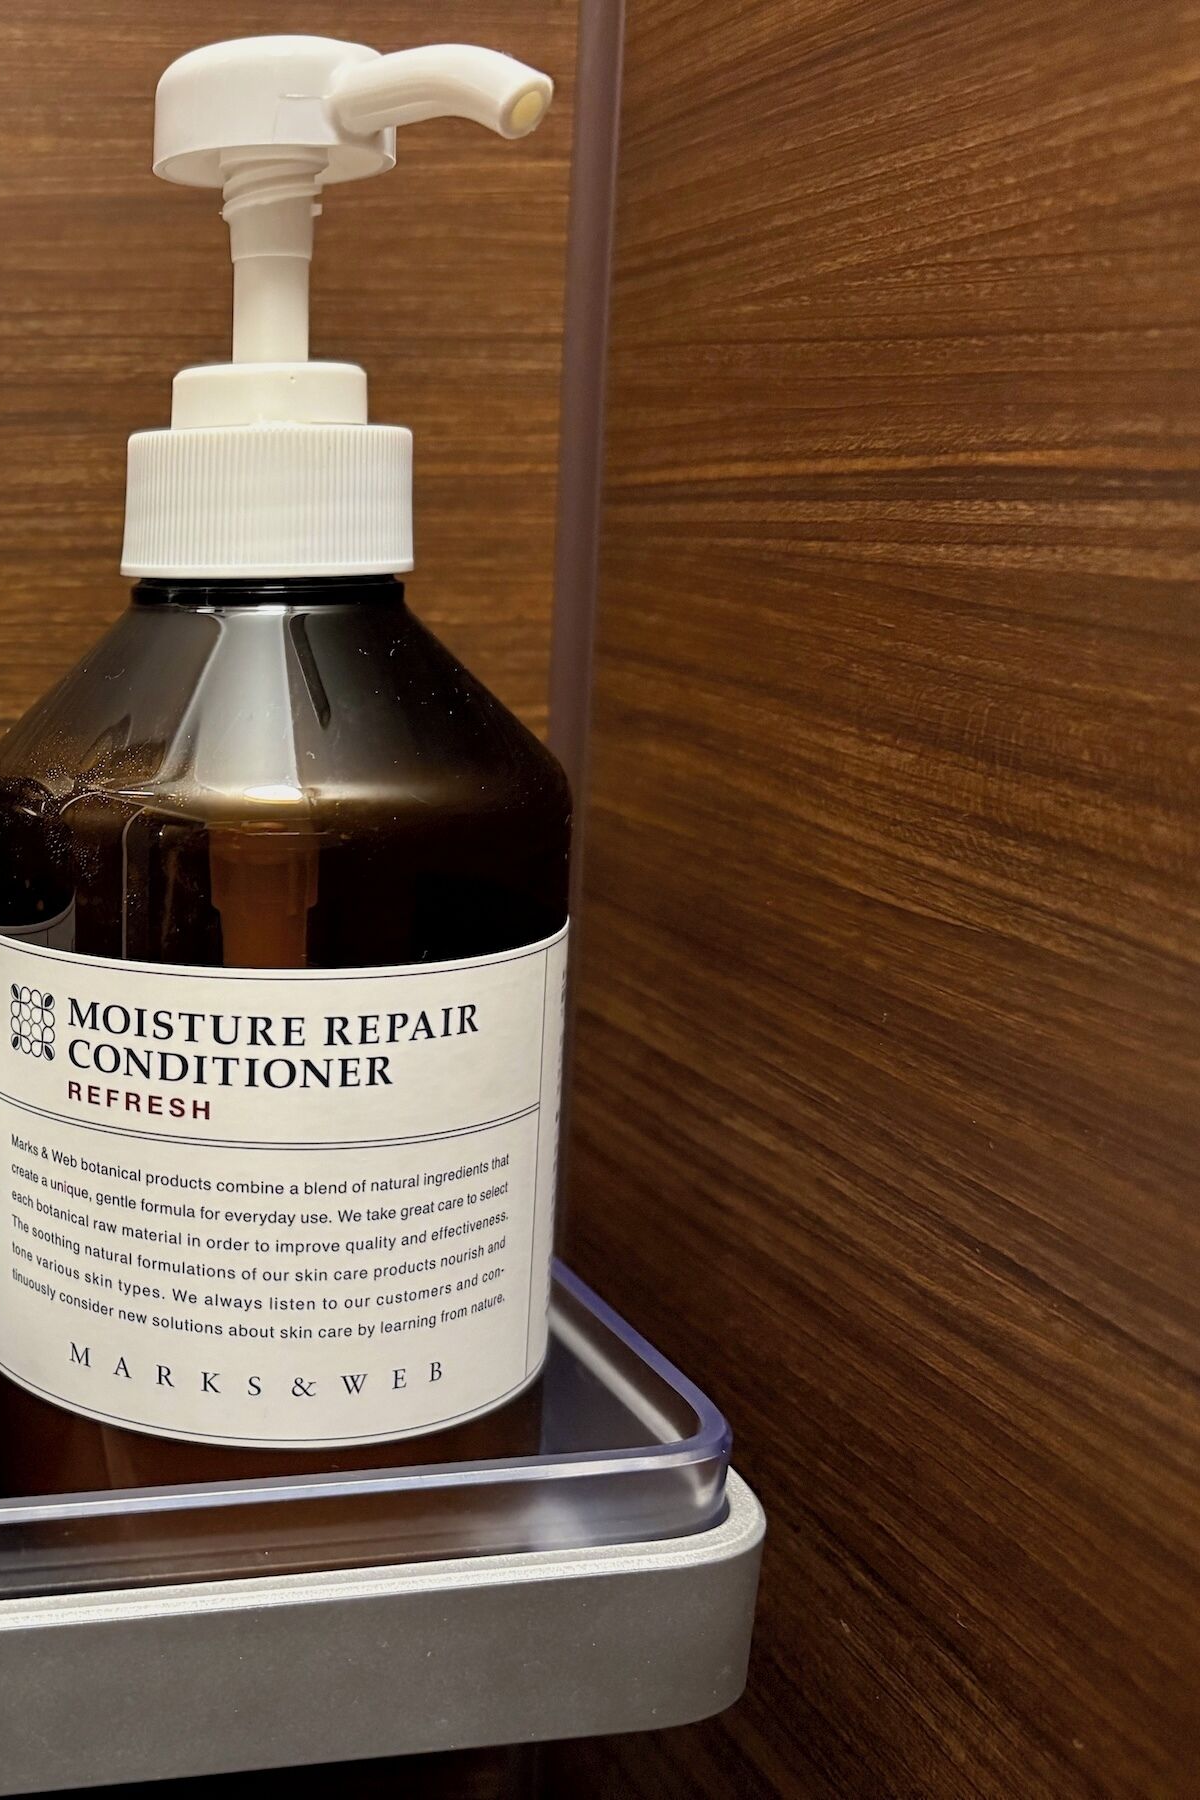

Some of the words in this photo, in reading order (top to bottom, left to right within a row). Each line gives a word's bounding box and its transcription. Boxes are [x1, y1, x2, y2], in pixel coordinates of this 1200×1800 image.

[67, 997, 306, 1046] MOISTURE
[323, 1004, 478, 1046] REPAIR
[68, 1039, 393, 1089] CONDITIONER
[68, 1080, 210, 1120] REFRESH
[11, 1133, 39, 1157] Marks
[41, 1146, 49, 1160] &
[51, 1149, 78, 1168] Web
[80, 1157, 141, 1182] botanical
[145, 1173, 212, 1191] products
[216, 1180, 285, 1195] combine
[289, 1184, 299, 1195] a
[304, 1180, 347, 1195] blend
[351, 1179, 367, 1193] of
[370, 1174, 420, 1192] natural
[423, 1162, 489, 1187] ingredients
[491, 1153, 509, 1170] that
[11, 1163, 39, 1184] create
[41, 1176, 48, 1187] a
[50, 1179, 92, 1203] unique,
[95, 1192, 137, 1210] gentle
[140, 1198, 196, 1219] formula
[200, 1206, 221, 1221] for
[224, 1210, 296, 1228] everyday
[300, 1213, 332, 1224] use.
[337, 1209, 363, 1223] We
[366, 1207, 397, 1221] take
[400, 1201, 435, 1221] great
[437, 1197, 464, 1212] care
[467, 1193, 477, 1205] to
[479, 1181, 508, 1202] select
[11, 1190, 34, 1209] each
[36, 1198, 89, 1227] botanical
[93, 1219, 117, 1234] raw
[122, 1226, 182, 1245] material
[187, 1233, 201, 1248] in
[206, 1237, 250, 1251] order
[254, 1239, 270, 1253] to
[275, 1239, 340, 1256] improve
[345, 1236, 397, 1255] quality
[401, 1230, 427, 1246] and
[431, 1211, 509, 1241] effectiveness.
[11, 1214, 29, 1234] The
[32, 1227, 80, 1255] soothing
[84, 1245, 132, 1266] natural
[137, 1254, 236, 1280] formulations
[241, 1267, 257, 1281] of
[262, 1271, 290, 1282] our
[295, 1268, 328, 1282] skin
[333, 1269, 368, 1281] care
[373, 1258, 436, 1281] products
[440, 1245, 485, 1268] nourish
[487, 1235, 506, 1254] and
[12, 1241, 33, 1262] tone
[36, 1255, 80, 1280] various
[84, 1272, 113, 1289] skin
[118, 1279, 165, 1300] types.
[172, 1288, 198, 1304] We
[204, 1293, 263, 1312] always
[269, 1297, 316, 1311] listen
[322, 1298, 338, 1310] to
[344, 1297, 371, 1309] our
[376, 1284, 452, 1306] customers
[456, 1273, 479, 1291] and
[481, 1267, 504, 1283] con-
[12, 1268, 56, 1301] tinuously
[59, 1292, 114, 1317] consider
[118, 1309, 147, 1325] new
[152, 1316, 223, 1336] solutions
[228, 1324, 275, 1339] about
[280, 1326, 313, 1339] skin
[318, 1327, 353, 1339] care
[358, 1323, 376, 1339] by
[380, 1315, 437, 1334] learning
[440, 1306, 468, 1323] from
[471, 1293, 505, 1314] nature.
